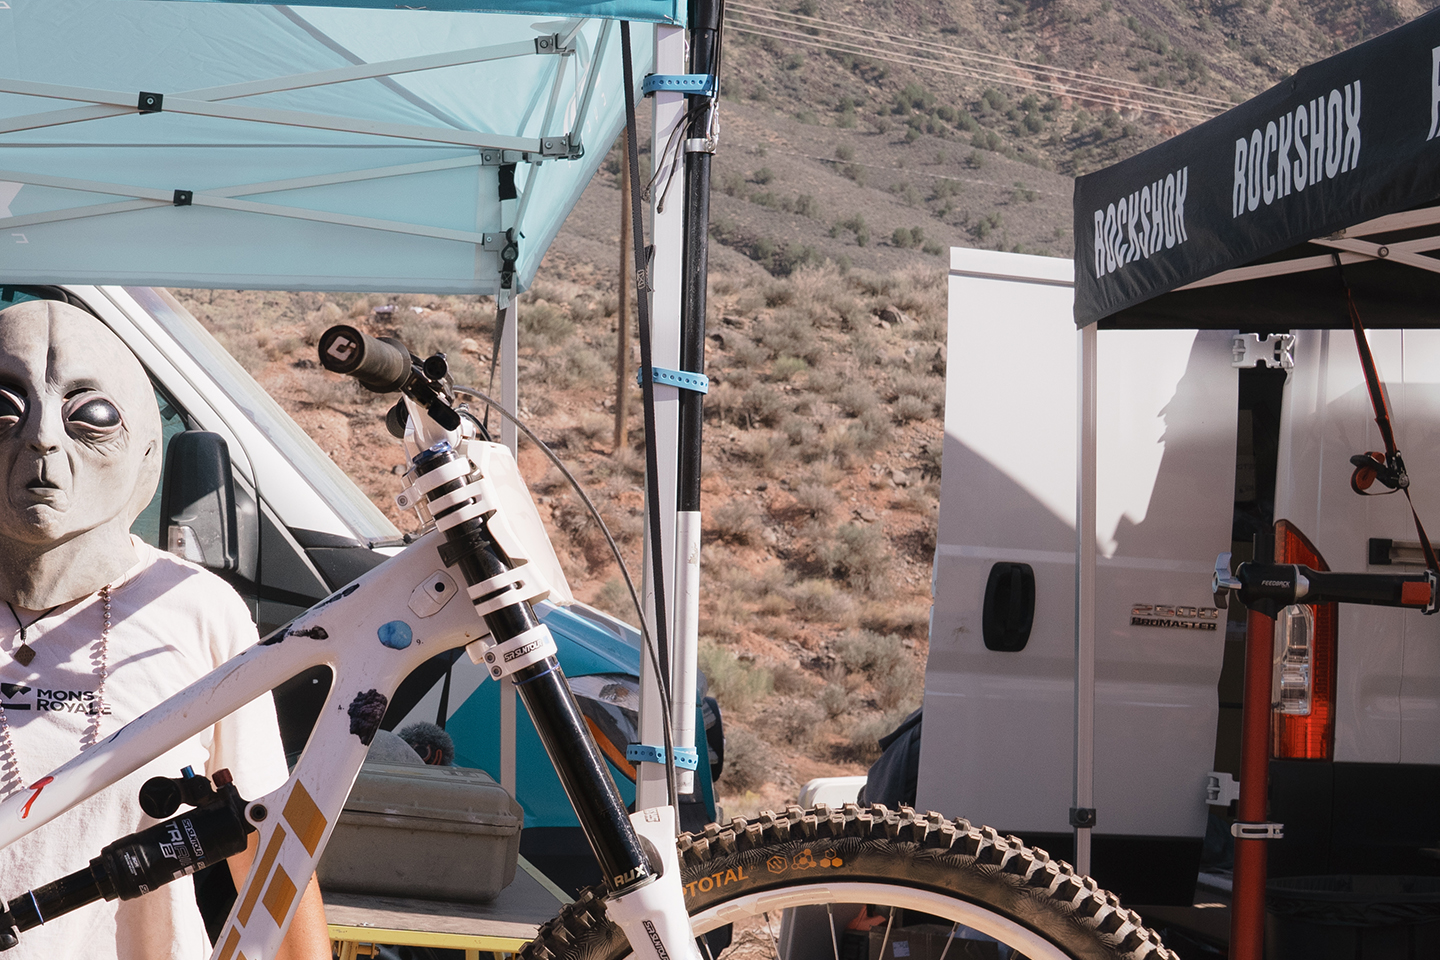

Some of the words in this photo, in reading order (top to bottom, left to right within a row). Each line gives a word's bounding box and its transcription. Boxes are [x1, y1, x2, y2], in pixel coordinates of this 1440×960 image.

[1233, 80, 1361, 218] ROCKSHOX
[1094, 166, 1189, 279] ROCKSHOX
[1131, 604, 1219, 619] 2500
[37, 688, 95, 702] MONS
[37, 699, 112, 716] ROYALE
